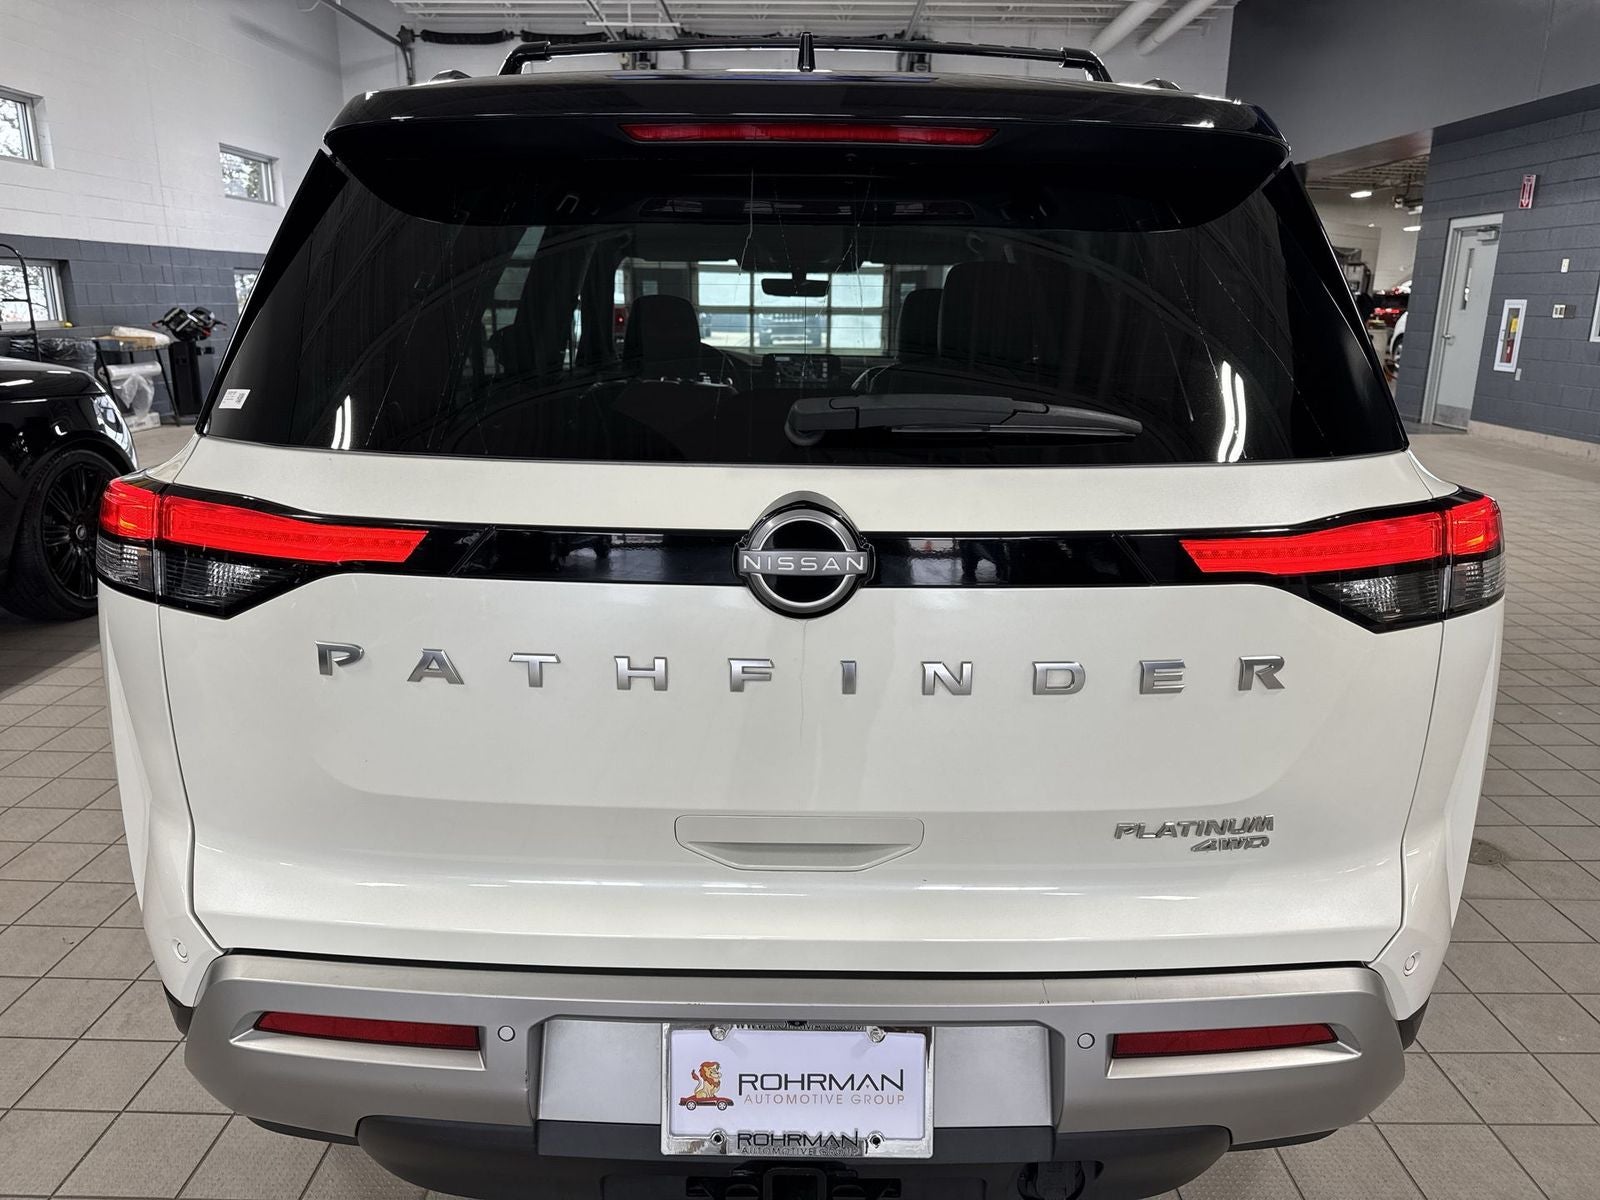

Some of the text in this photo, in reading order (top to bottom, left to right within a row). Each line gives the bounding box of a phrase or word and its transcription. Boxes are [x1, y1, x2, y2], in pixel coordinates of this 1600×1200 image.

[743, 555, 864, 571] NISSAN
[314, 640, 1286, 695] PATHFINDER
[1114, 815, 1274, 839] PLATINUM
[1191, 834, 1270, 852] 4WD
[738, 1069, 904, 1096] ROHRMAN
[744, 1093, 905, 1105] AUTOMOTIVE GROUP
[737, 1130, 858, 1149] ROHRMAN
[741, 1146, 815, 1155] AUTOMOTIVE
